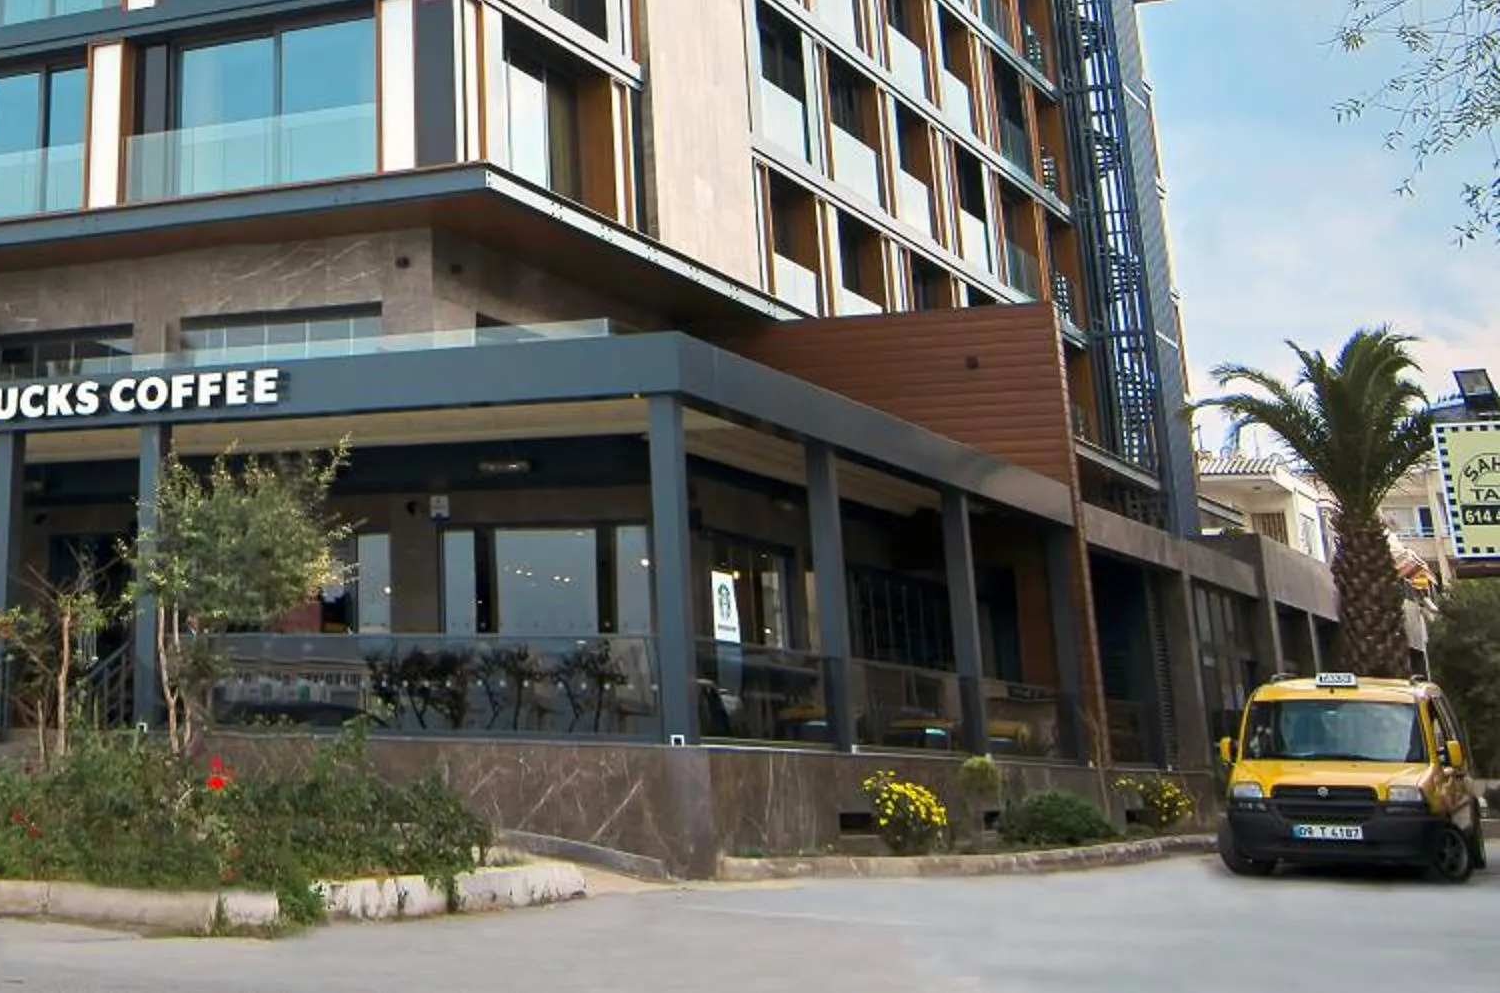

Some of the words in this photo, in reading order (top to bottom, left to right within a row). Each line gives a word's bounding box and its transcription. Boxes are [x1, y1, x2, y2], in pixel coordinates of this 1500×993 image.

[109, 368, 279, 412] COFFEE
[1465, 509, 1492, 524] 614
[1319, 826, 1326, 837] T
